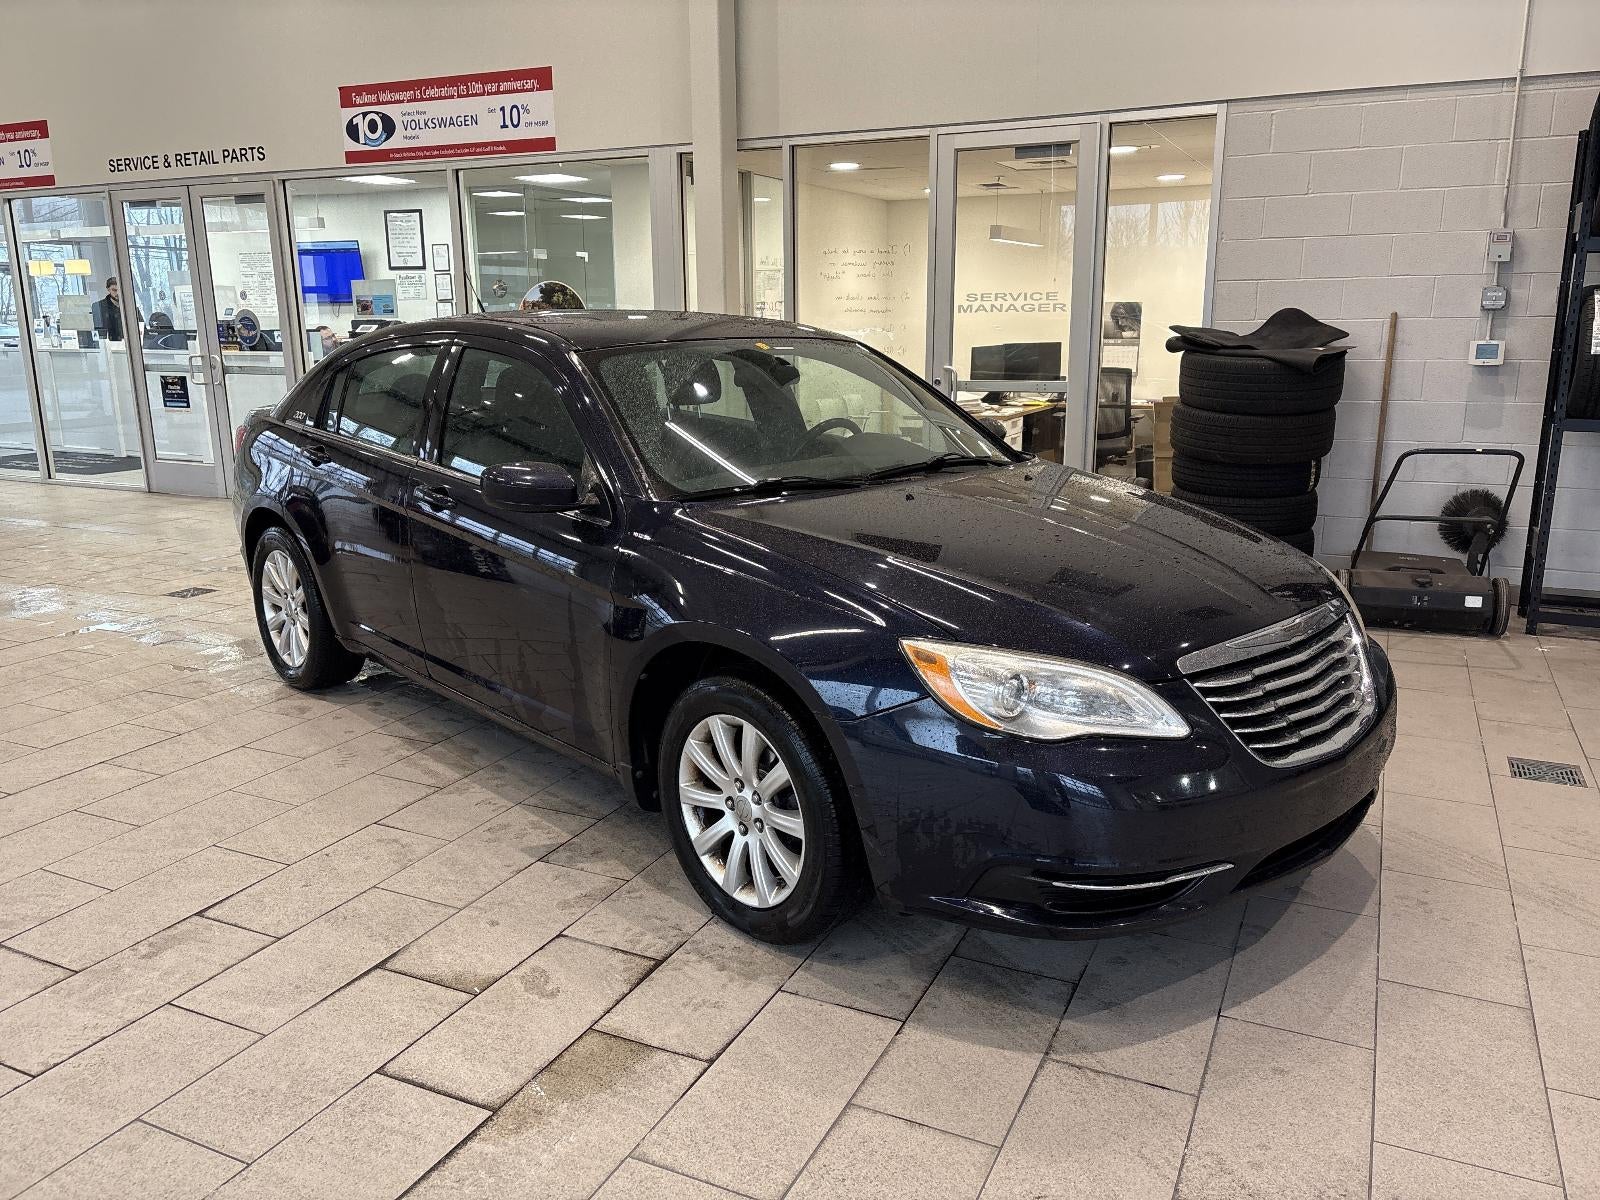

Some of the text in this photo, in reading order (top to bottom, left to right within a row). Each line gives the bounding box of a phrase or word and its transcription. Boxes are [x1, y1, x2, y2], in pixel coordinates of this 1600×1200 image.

[352, 92, 378, 104] Faulkner
[378, 89, 415, 103] Volkswagen
[415, 87, 421, 99] is
[421, 84, 458, 99] Celebrating
[468, 81, 483, 94] 10th
[484, 82, 498, 96] year
[500, 78, 540, 92] anniversary.
[402, 114, 478, 131] VOLKSWAGEN
[108, 145, 266, 173] SERVICE & RETAIL PARTS
[965, 291, 1059, 302] SERVICE
[957, 303, 1067, 313] MANAGER
